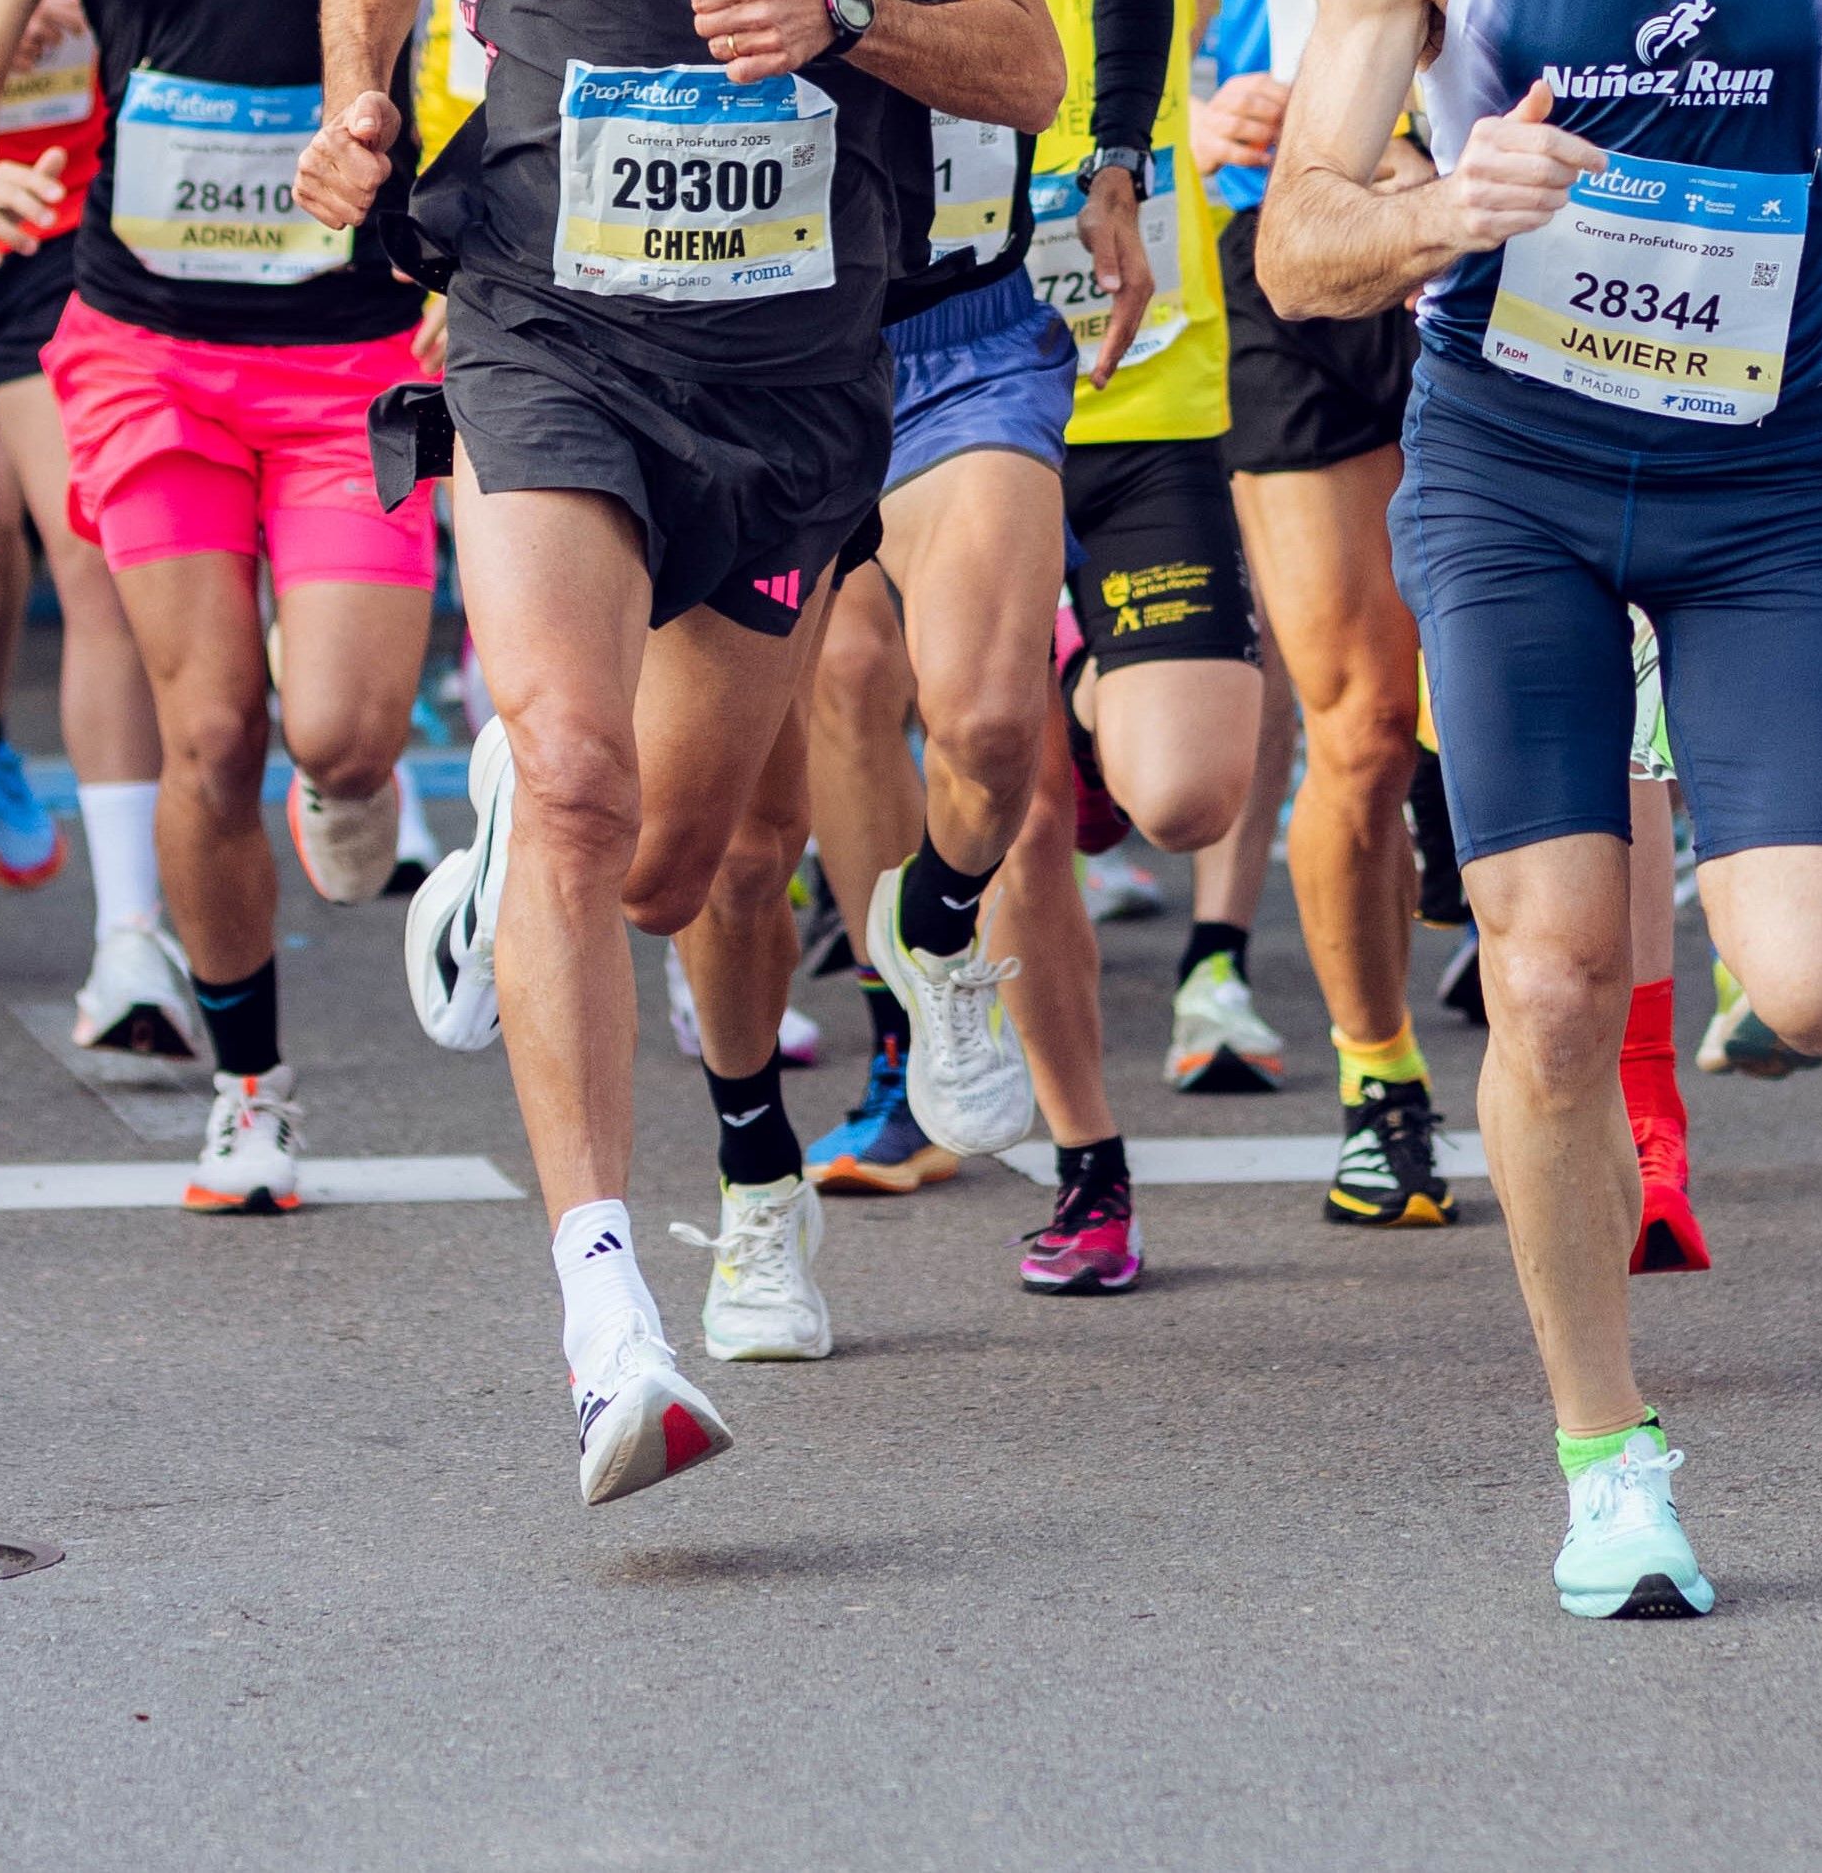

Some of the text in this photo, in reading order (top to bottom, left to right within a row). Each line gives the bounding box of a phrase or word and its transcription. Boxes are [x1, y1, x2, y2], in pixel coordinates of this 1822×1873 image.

[580, 79, 700, 105] ProFuturo
[1541, 59, 1775, 100] Núñez Run
[1669, 91, 1769, 107] TALAVERA
[627, 133, 771, 148] Carrera ProFuturo 2025
[174, 180, 295, 213] 28410
[611, 156, 783, 214] 29300
[644, 227, 747, 262] CHEMA
[1575, 220, 1735, 258] Carrera ProFuturo 2025
[582, 266, 605, 277] ADM
[656, 275, 712, 288] MADRID
[1569, 271, 1721, 334] 28344
[1502, 346, 1529, 363] ADM
[1560, 326, 1709, 377] JAVIER R
[1581, 376, 1641, 400] MADRID
